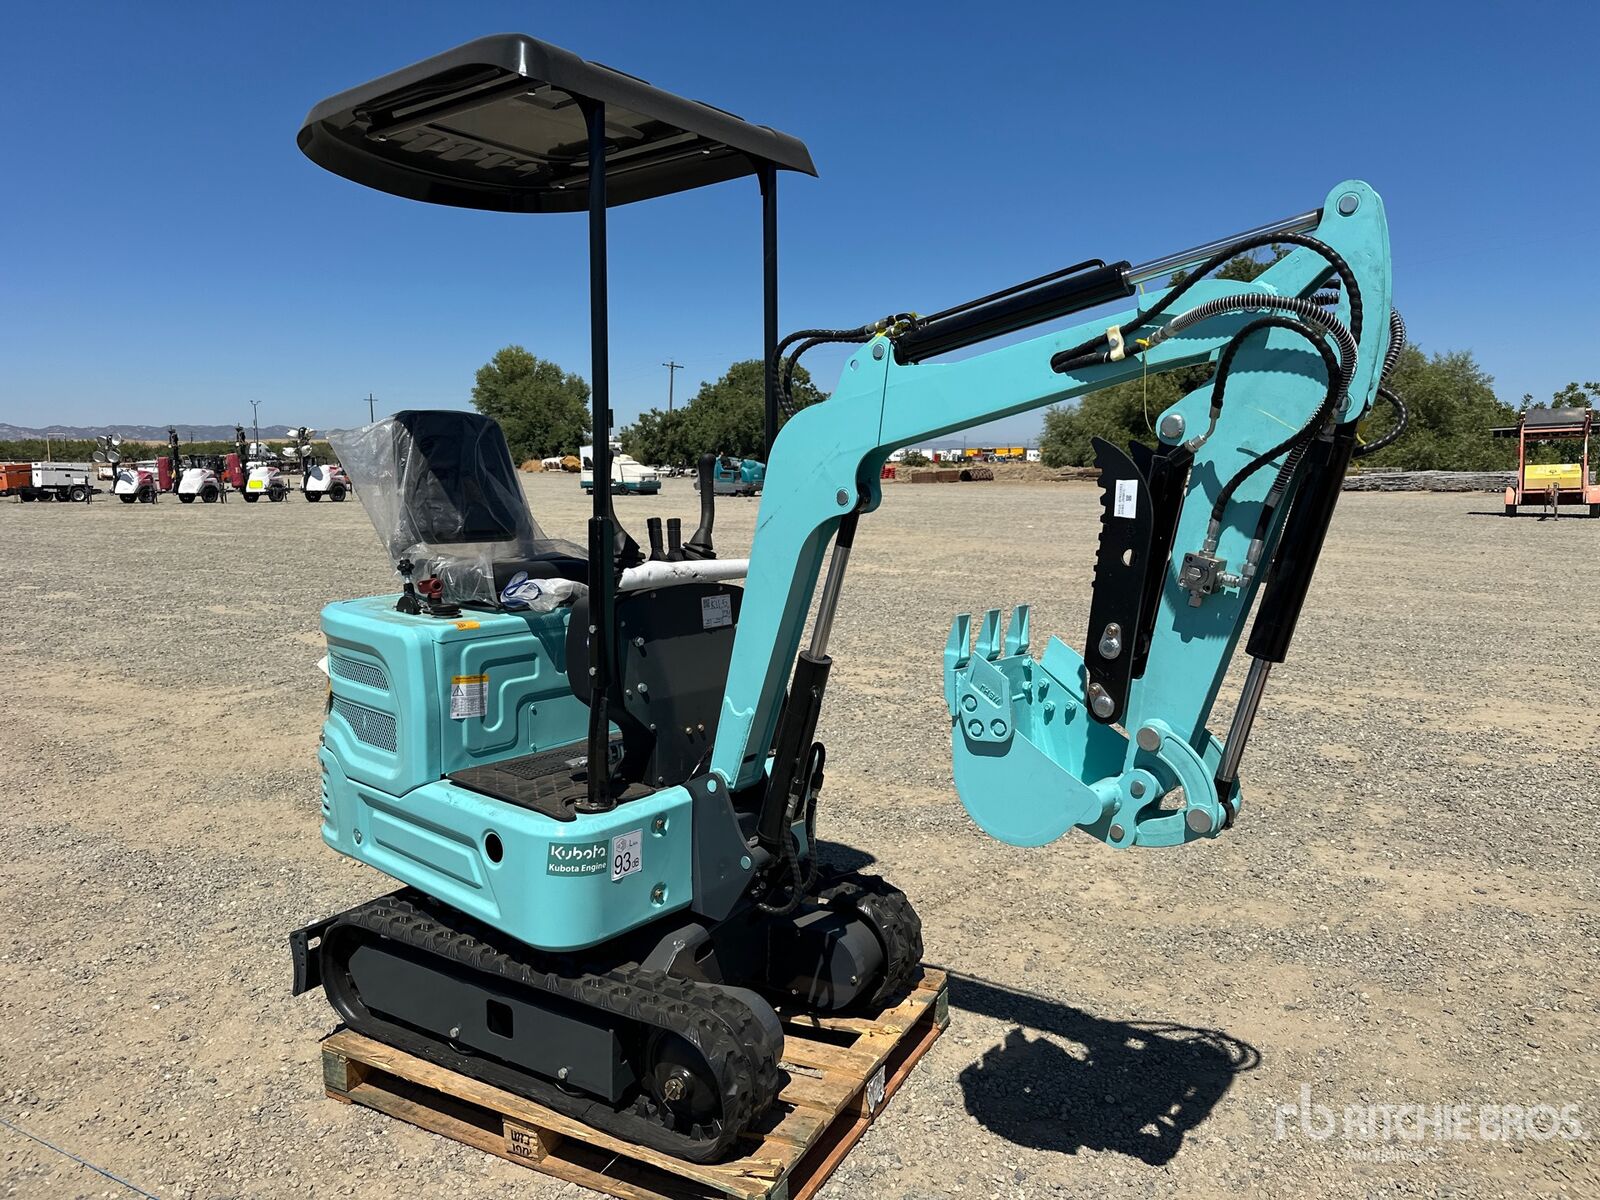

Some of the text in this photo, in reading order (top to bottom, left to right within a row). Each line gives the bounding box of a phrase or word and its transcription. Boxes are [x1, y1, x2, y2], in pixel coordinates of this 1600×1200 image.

[551, 845, 606, 860] Kubota
[548, 862, 607, 873] Kubota Engine
[614, 851, 640, 875] 93 dB
